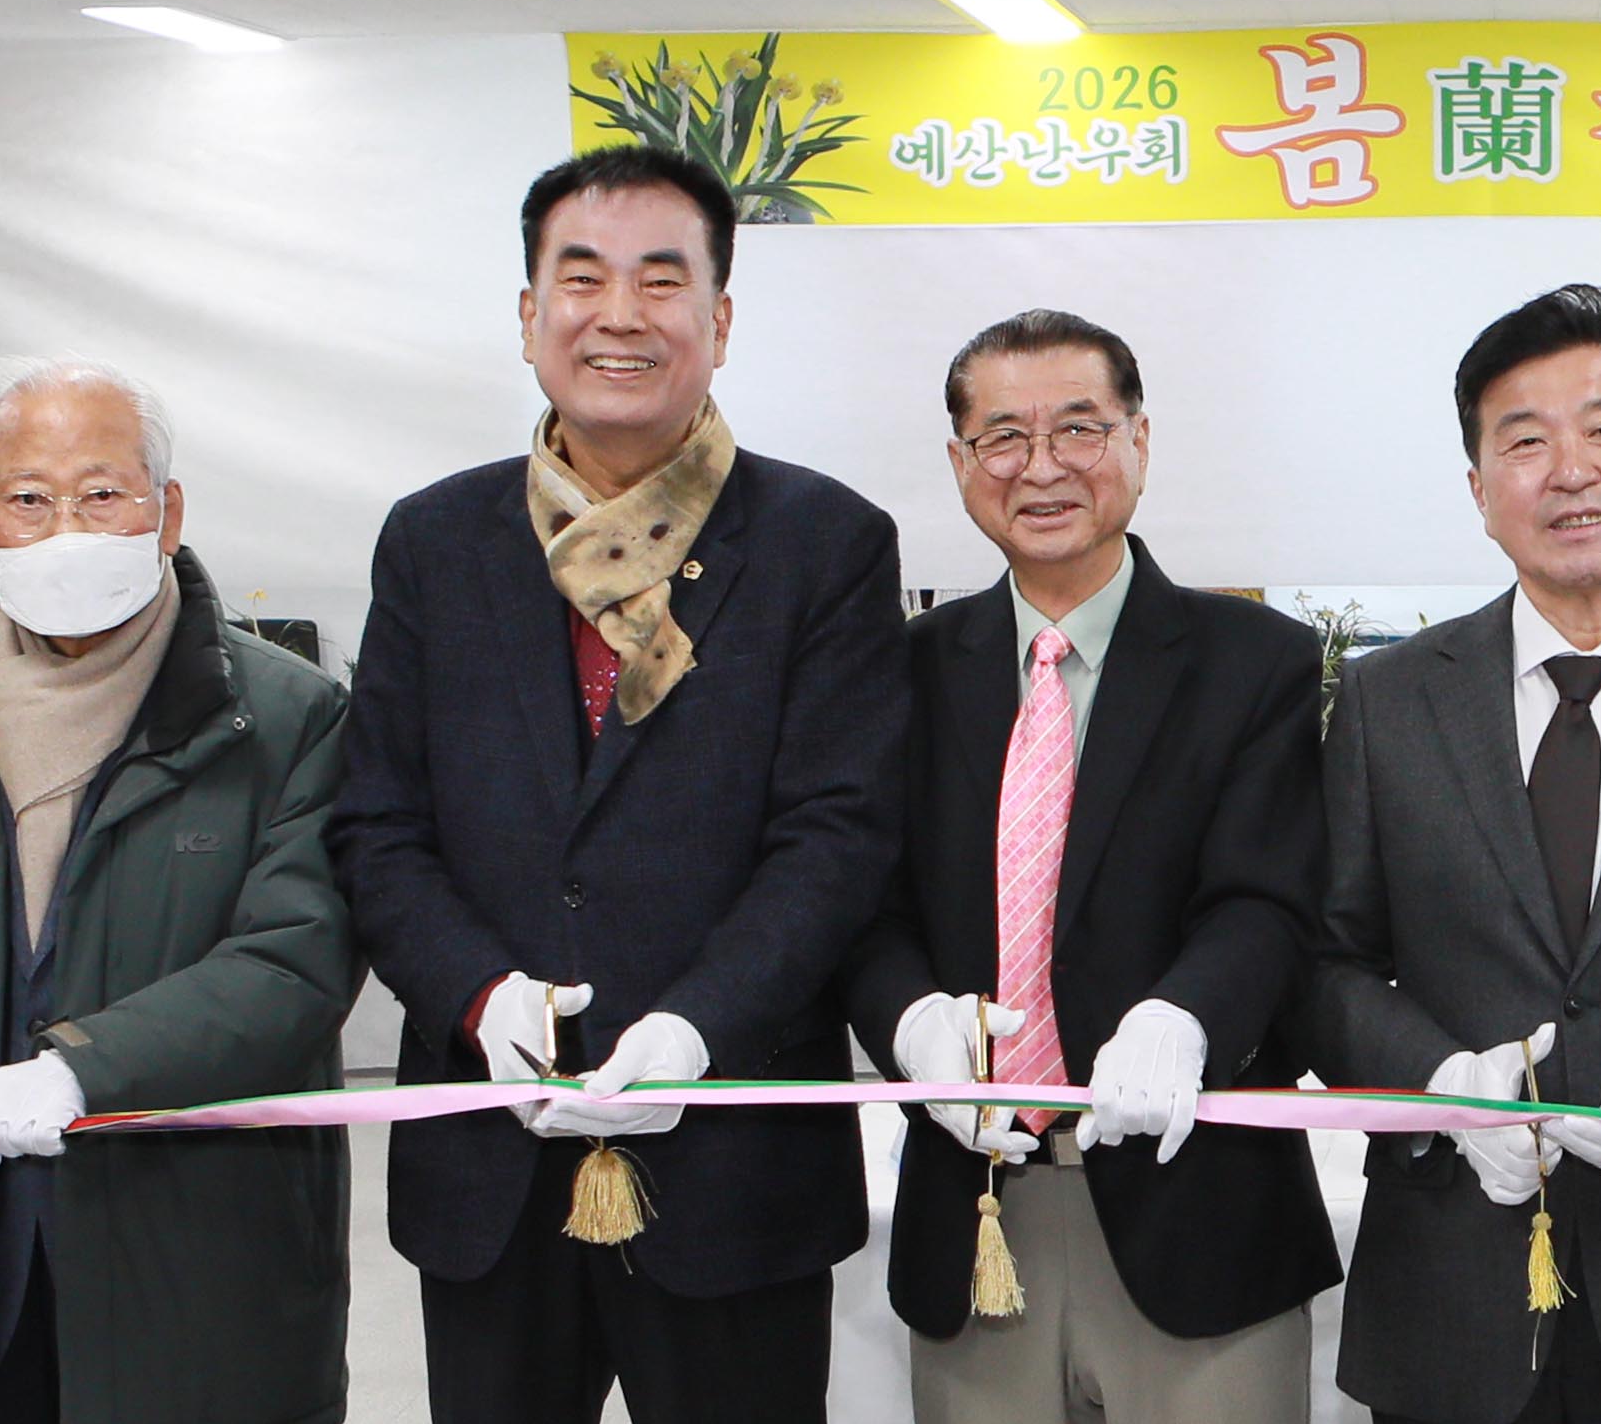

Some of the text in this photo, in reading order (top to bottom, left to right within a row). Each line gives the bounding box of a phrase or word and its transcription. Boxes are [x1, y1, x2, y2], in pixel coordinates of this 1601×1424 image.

[1039, 63, 1179, 112] 2026
[891, 120, 1182, 181] 예산난우회
[1216, 32, 1406, 209] 봄
[1432, 60, 1560, 177] 蘭
